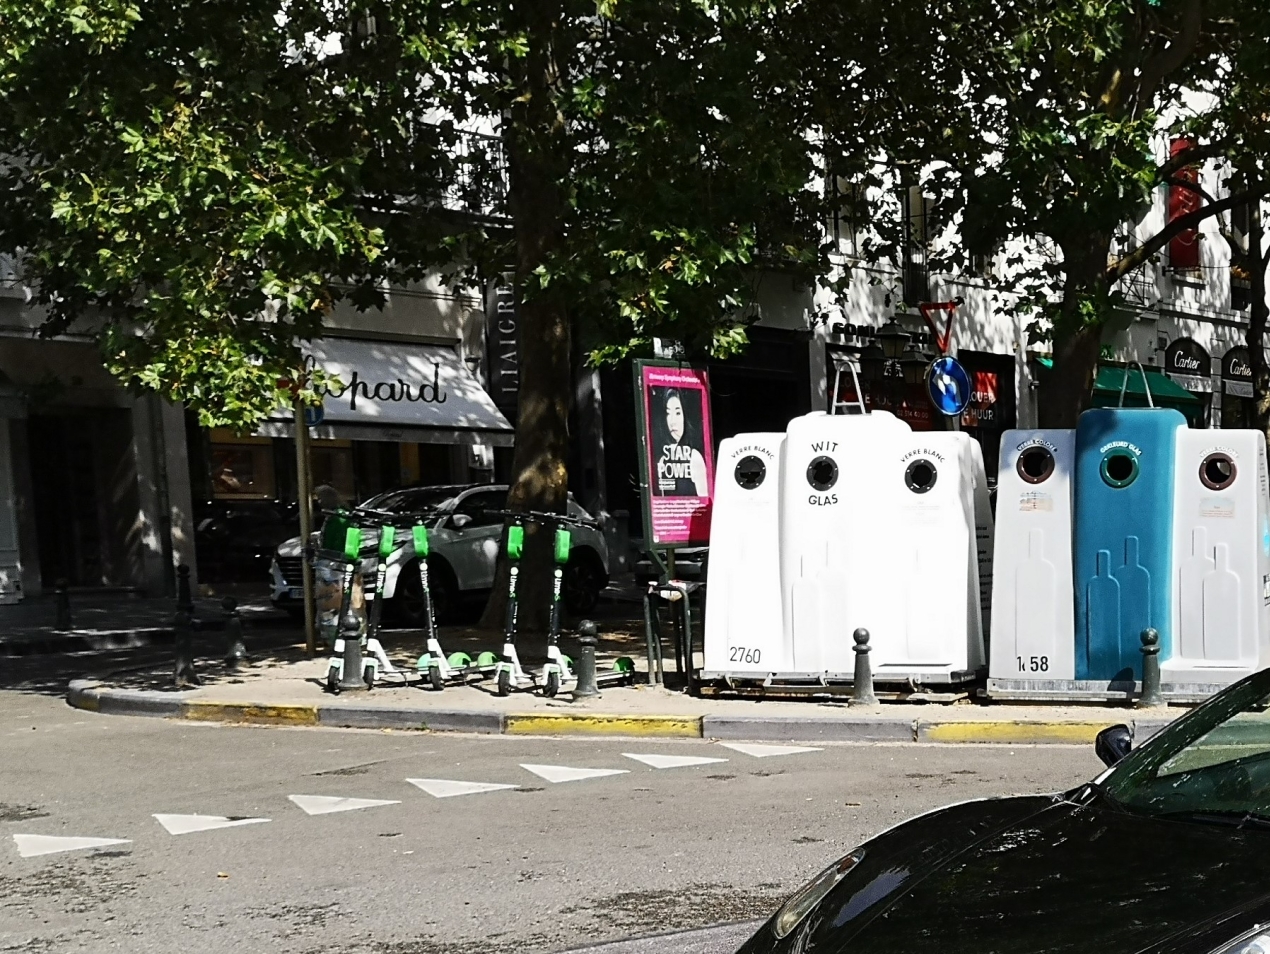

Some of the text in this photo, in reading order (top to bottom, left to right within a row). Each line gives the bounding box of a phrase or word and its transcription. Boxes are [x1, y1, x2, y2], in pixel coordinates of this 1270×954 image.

[1174, 350, 1201, 370] Cartier
[971, 409, 994, 420] HUUR
[663, 443, 691, 461] STAR
[731, 446, 775, 460] VERRE BLANC
[811, 441, 839, 453] WIT
[900, 448, 946, 463] VERRE BLANC
[808, 494, 839, 506] GLAS
[729, 647, 761, 664] 2760
